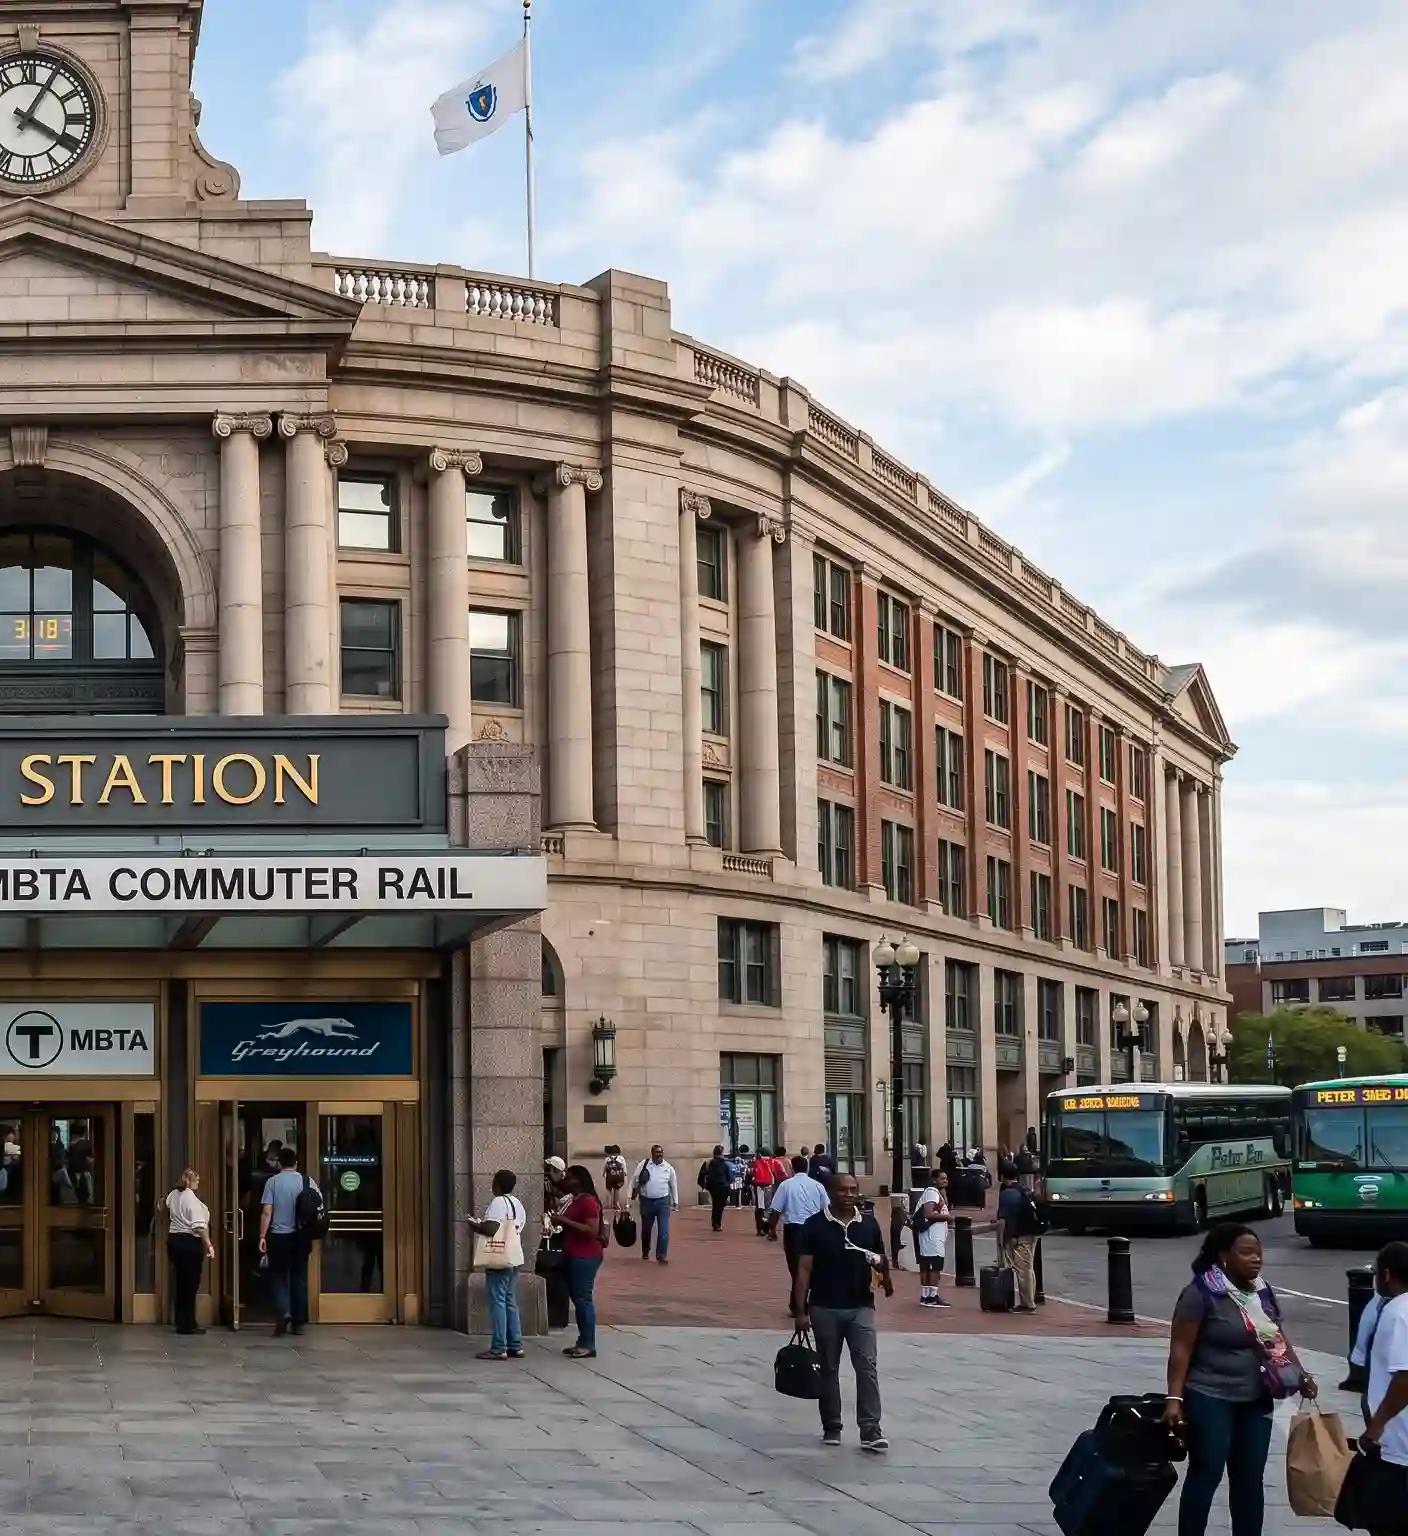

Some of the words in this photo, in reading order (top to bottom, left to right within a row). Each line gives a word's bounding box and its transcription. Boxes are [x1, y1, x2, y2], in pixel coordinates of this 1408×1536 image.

[20, 753, 320, 805] STATION
[109, 868, 358, 901] COMMUTER
[378, 868, 472, 900] RAIL
[16, 1026, 53, 1059] T
[70, 1029, 149, 1051] MBTA
[231, 1041, 381, 1062] Greyhound
[1317, 1091, 1355, 1102] PETER
